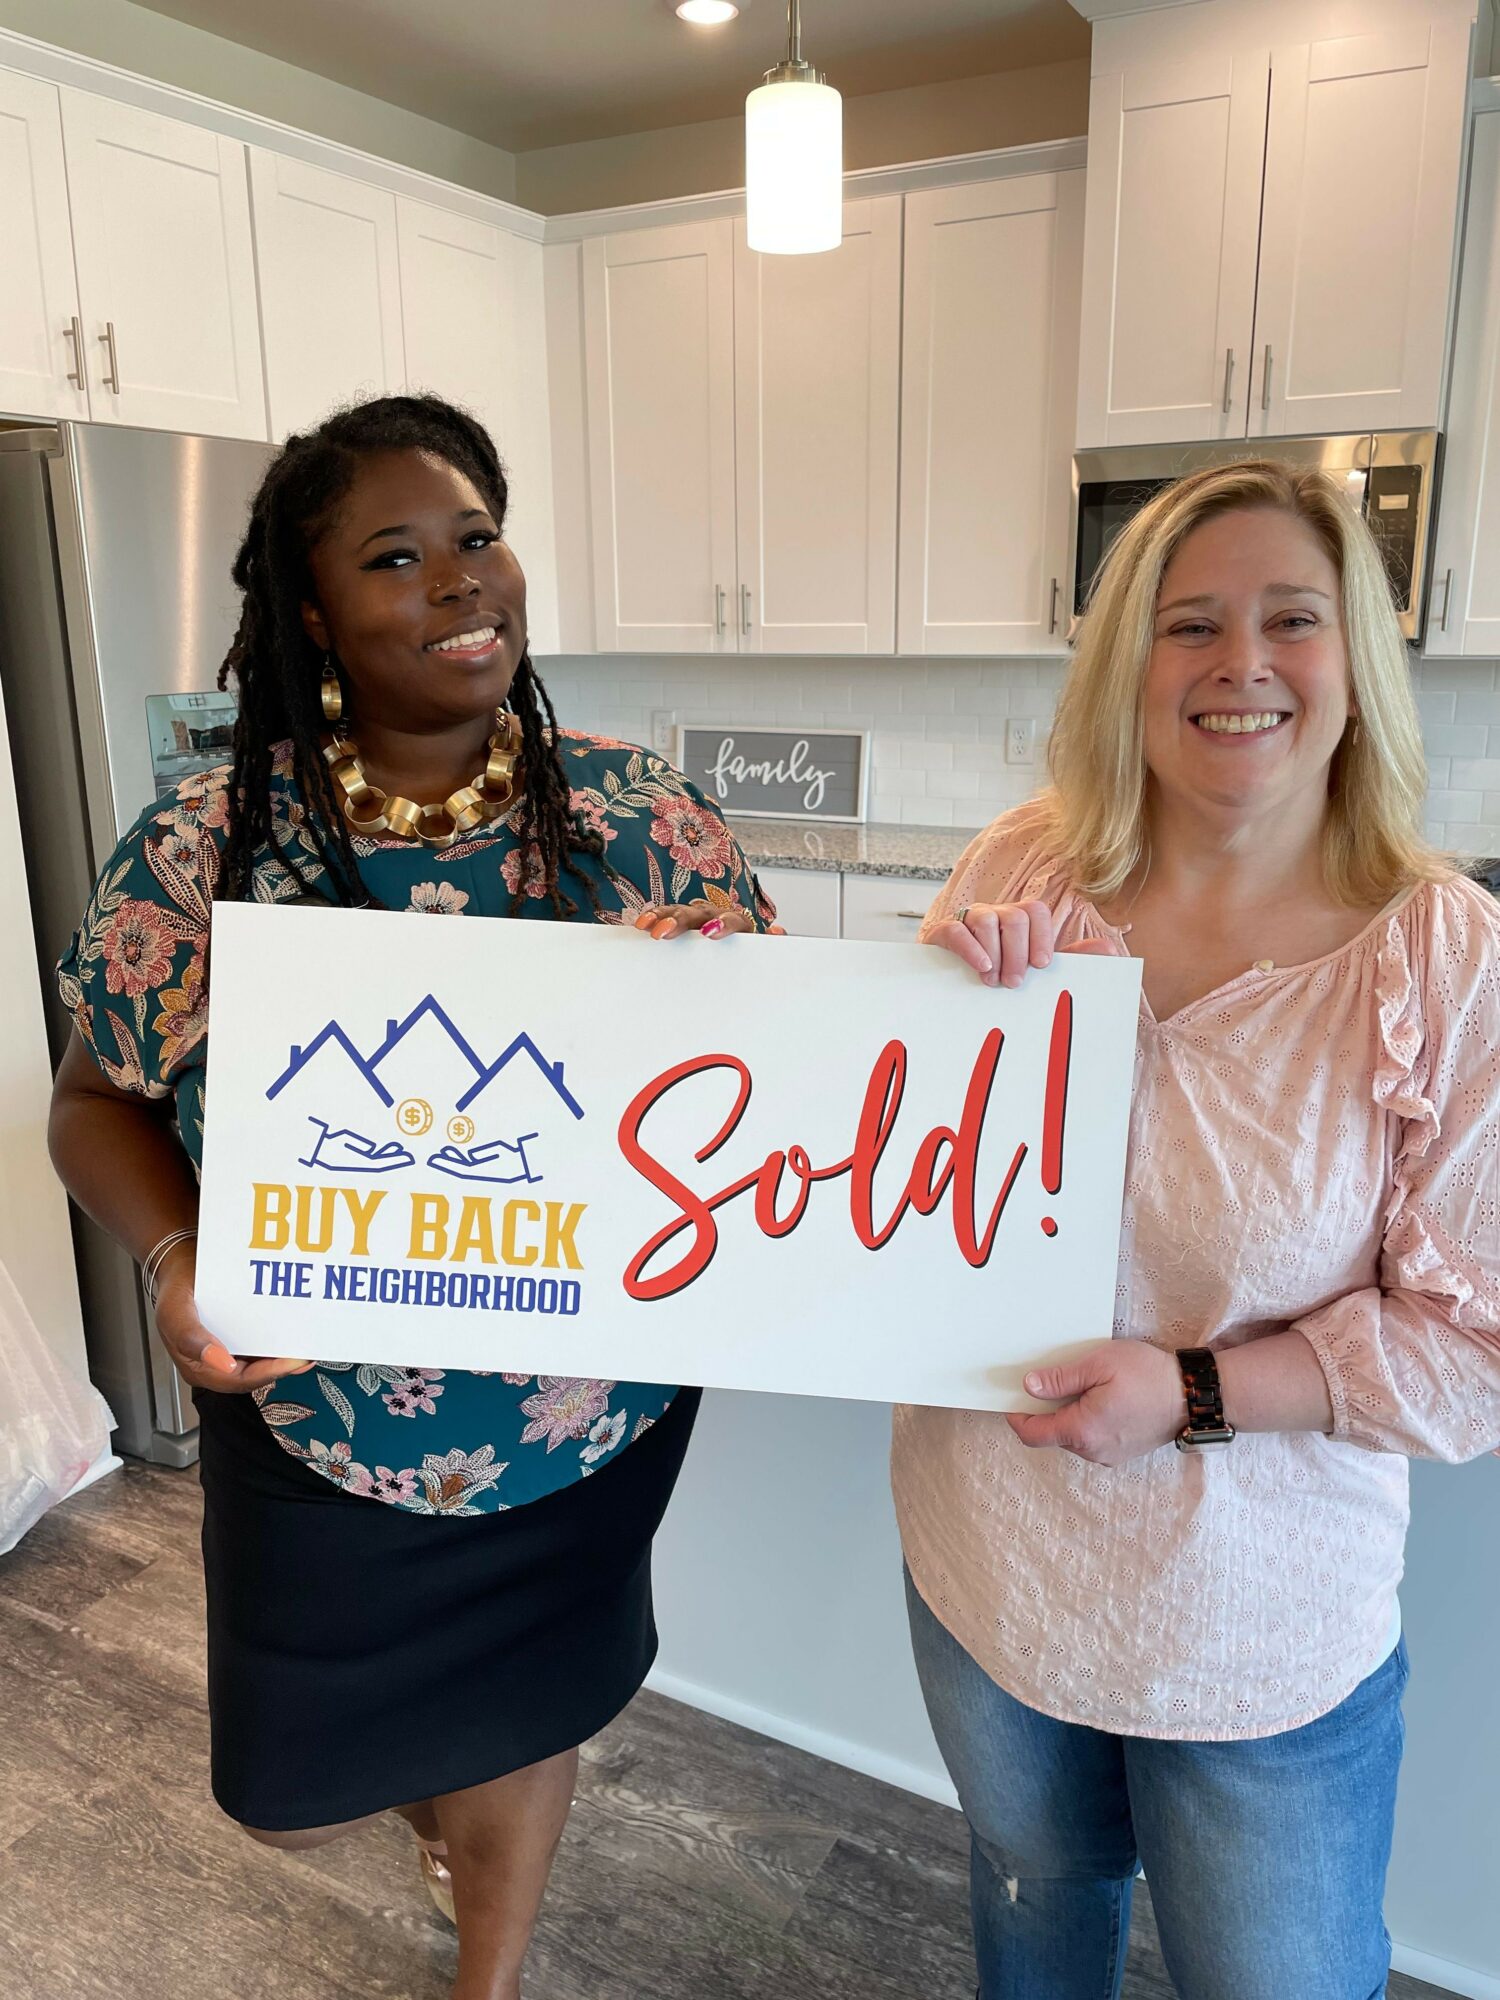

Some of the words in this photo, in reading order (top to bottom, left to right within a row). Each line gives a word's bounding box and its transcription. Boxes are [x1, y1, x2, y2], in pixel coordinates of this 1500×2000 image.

[704, 737, 836, 810] family
[617, 989, 1074, 1303] Sold!
[248, 1182, 389, 1257] BUY
[406, 1192, 588, 1270] BACK
[250, 1260, 313, 1299] THE
[323, 1264, 582, 1317] NEIGHBORHOOD
